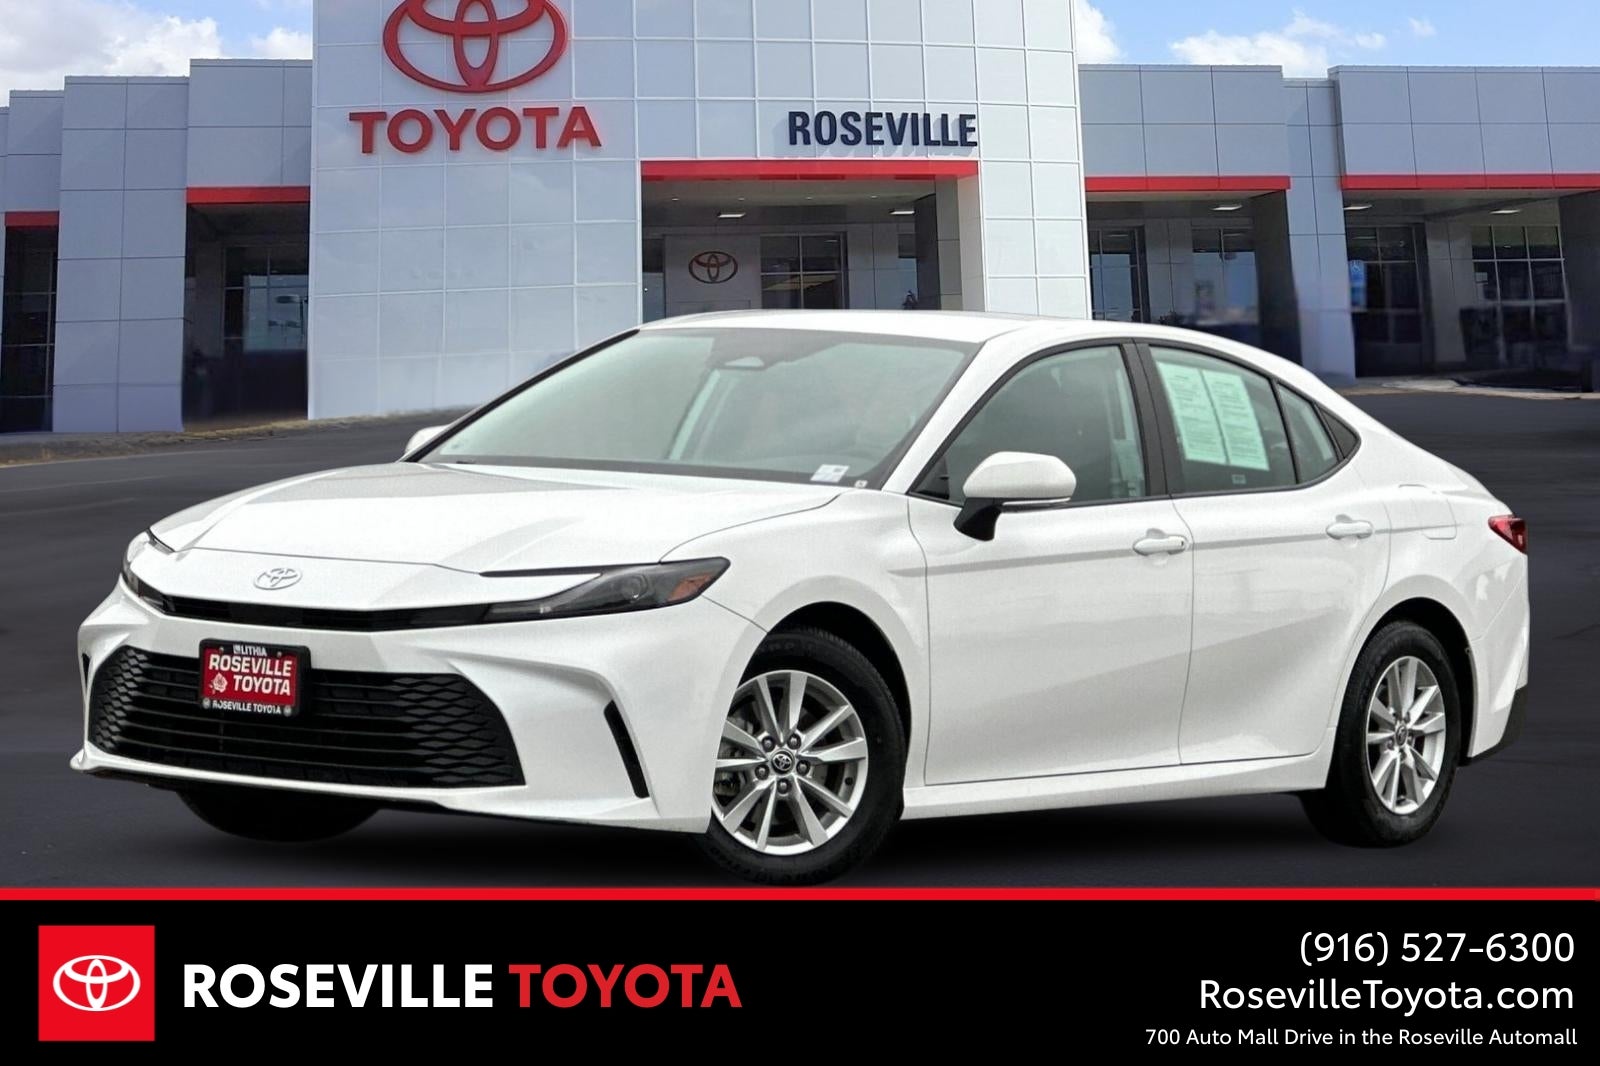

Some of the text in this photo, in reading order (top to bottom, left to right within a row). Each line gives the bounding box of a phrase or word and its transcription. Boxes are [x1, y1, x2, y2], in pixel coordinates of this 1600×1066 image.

[348, 105, 603, 154] TOYOTA
[788, 110, 979, 147] ROSEVILLE
[241, 645, 267, 656] LITHIA
[209, 654, 292, 676] ROSEVILLE
[233, 675, 291, 696] TOYOTA
[212, 699, 281, 714] ROSEVILLE TOYOTA
